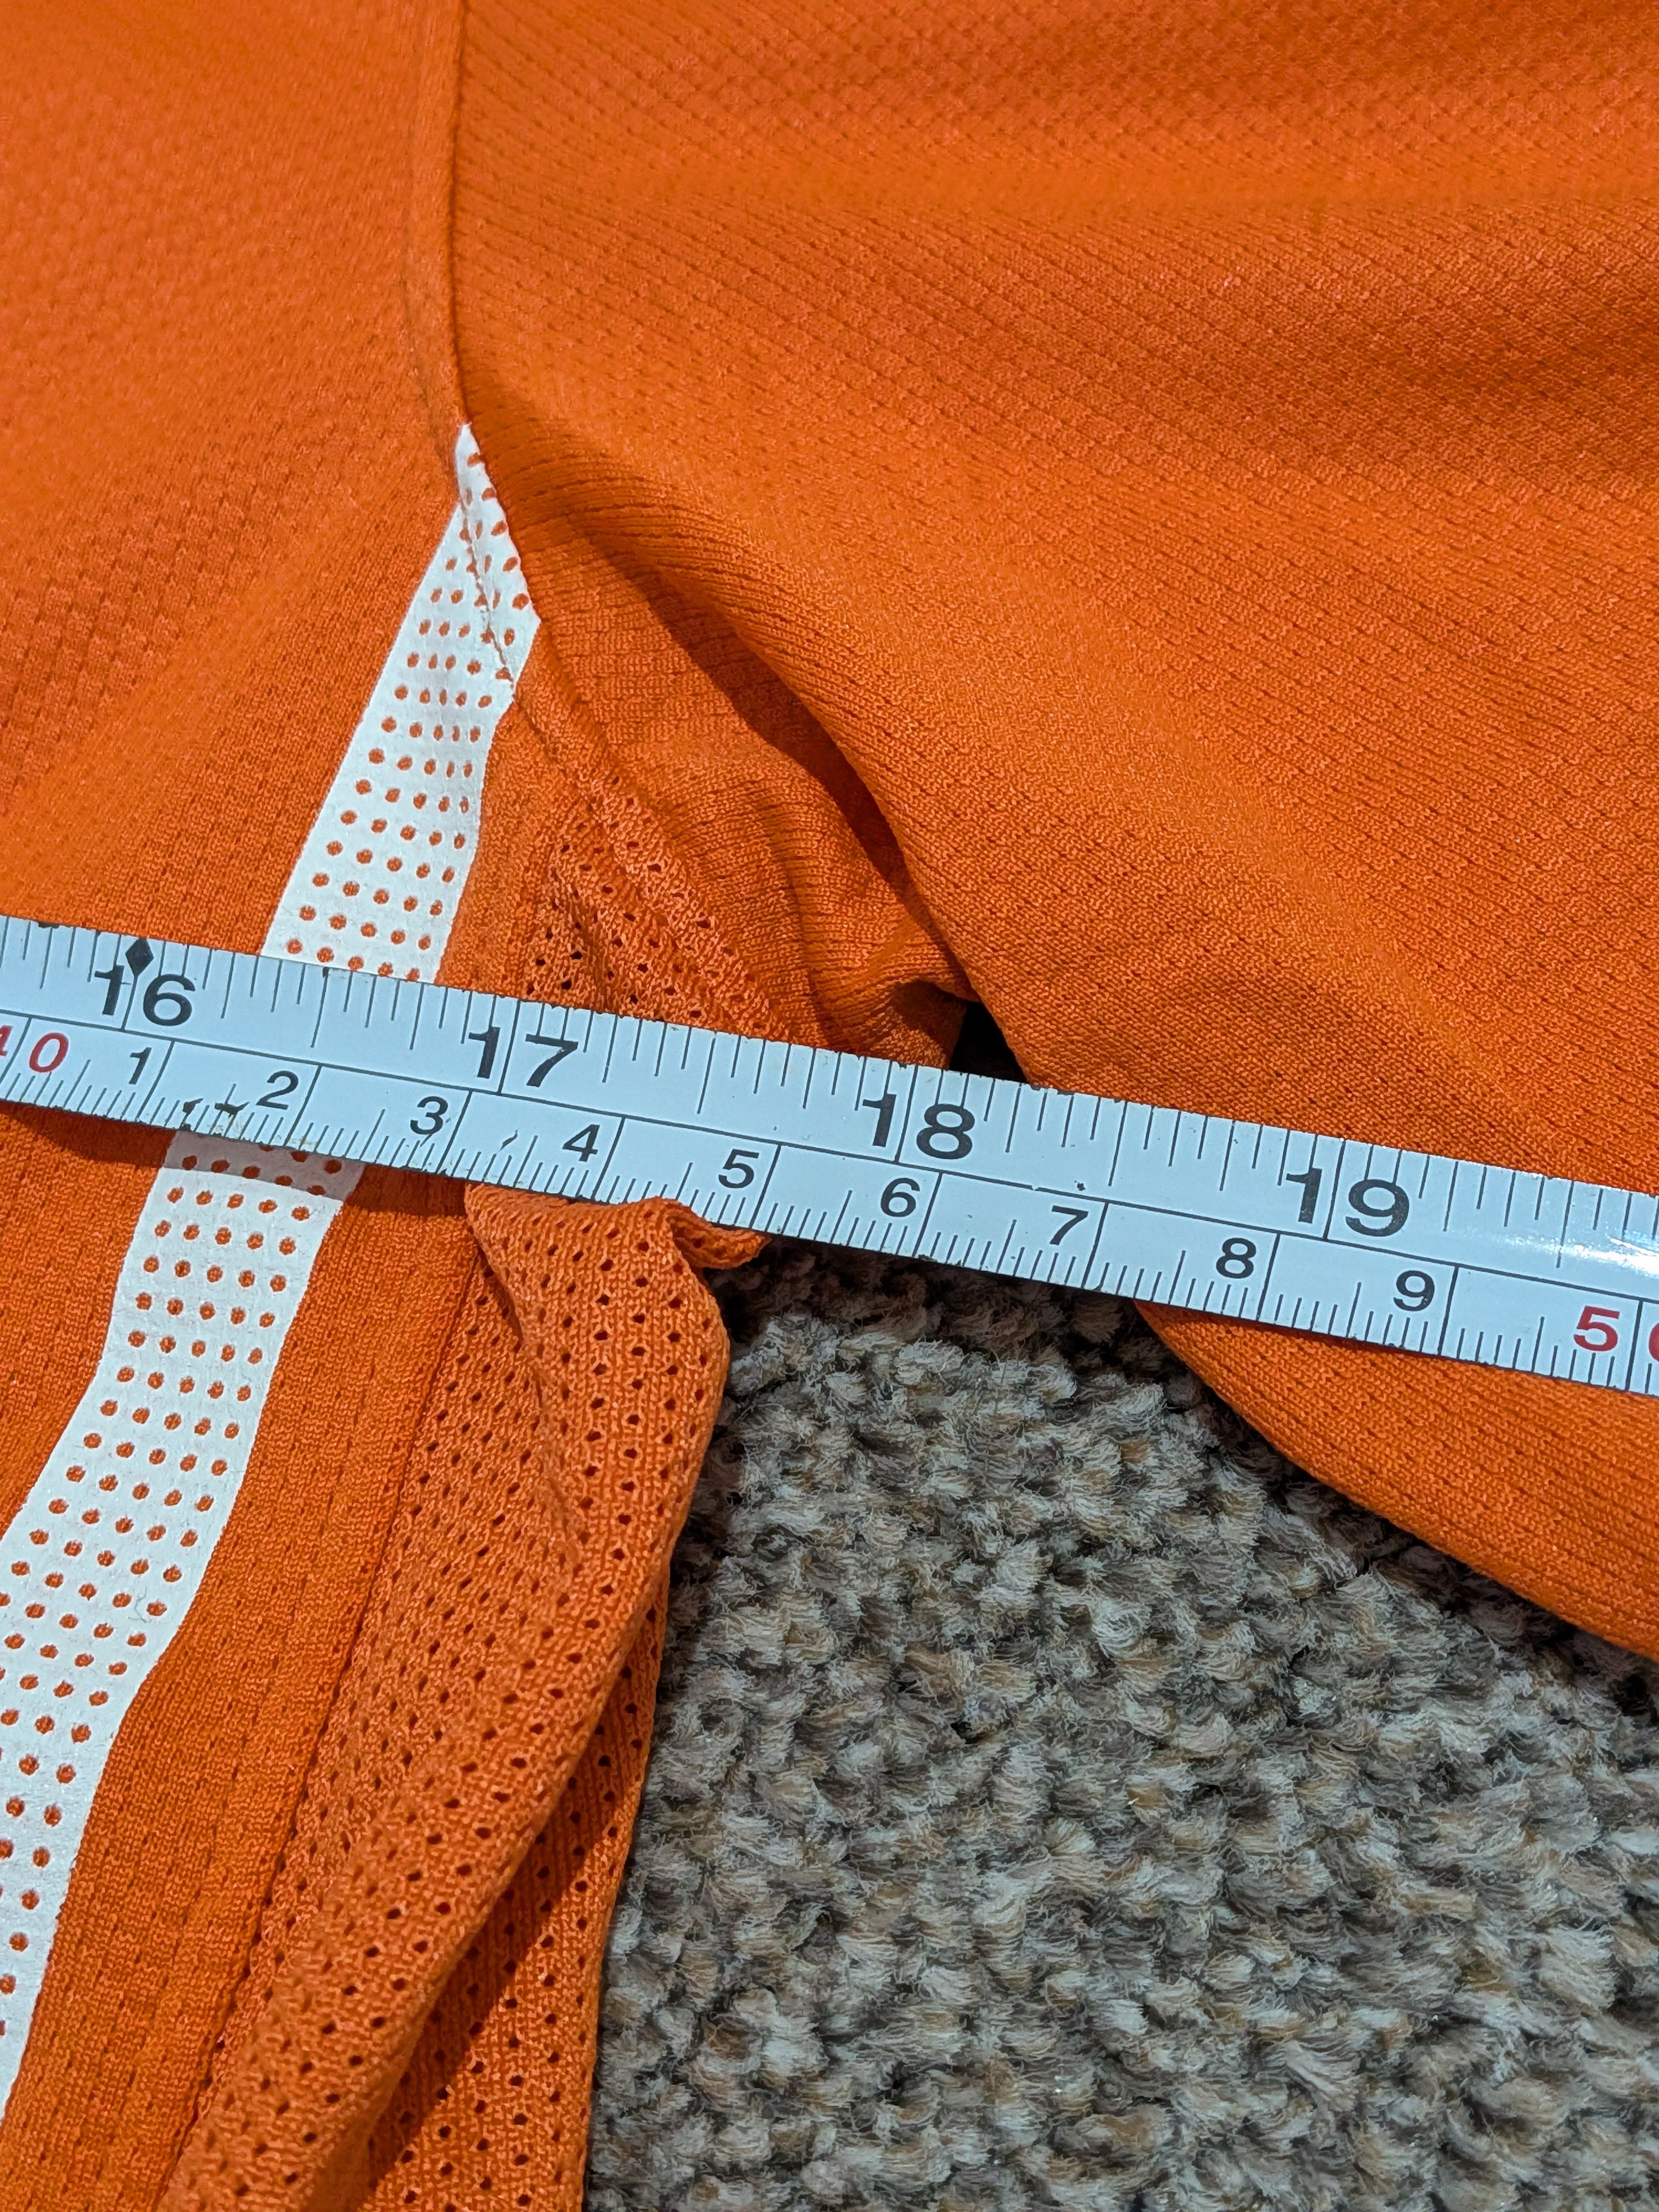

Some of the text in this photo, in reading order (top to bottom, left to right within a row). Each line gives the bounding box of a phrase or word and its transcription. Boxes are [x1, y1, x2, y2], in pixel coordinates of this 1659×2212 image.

[95, 965, 1410, 1237] 16 17 18 19
[129, 1047, 152, 1084] 1
[256, 1070, 299, 1110] 2
[410, 1095, 448, 1135] 3
[562, 1124, 601, 1162] 4
[718, 1149, 759, 1189] 5
[880, 1178, 920, 1218] 6
[1050, 1205, 1089, 1245] 7
[1216, 1238, 1256, 1279] 8
[1393, 1270, 1435, 1312] 9
[1573, 1305, 1659, 1363] 5
